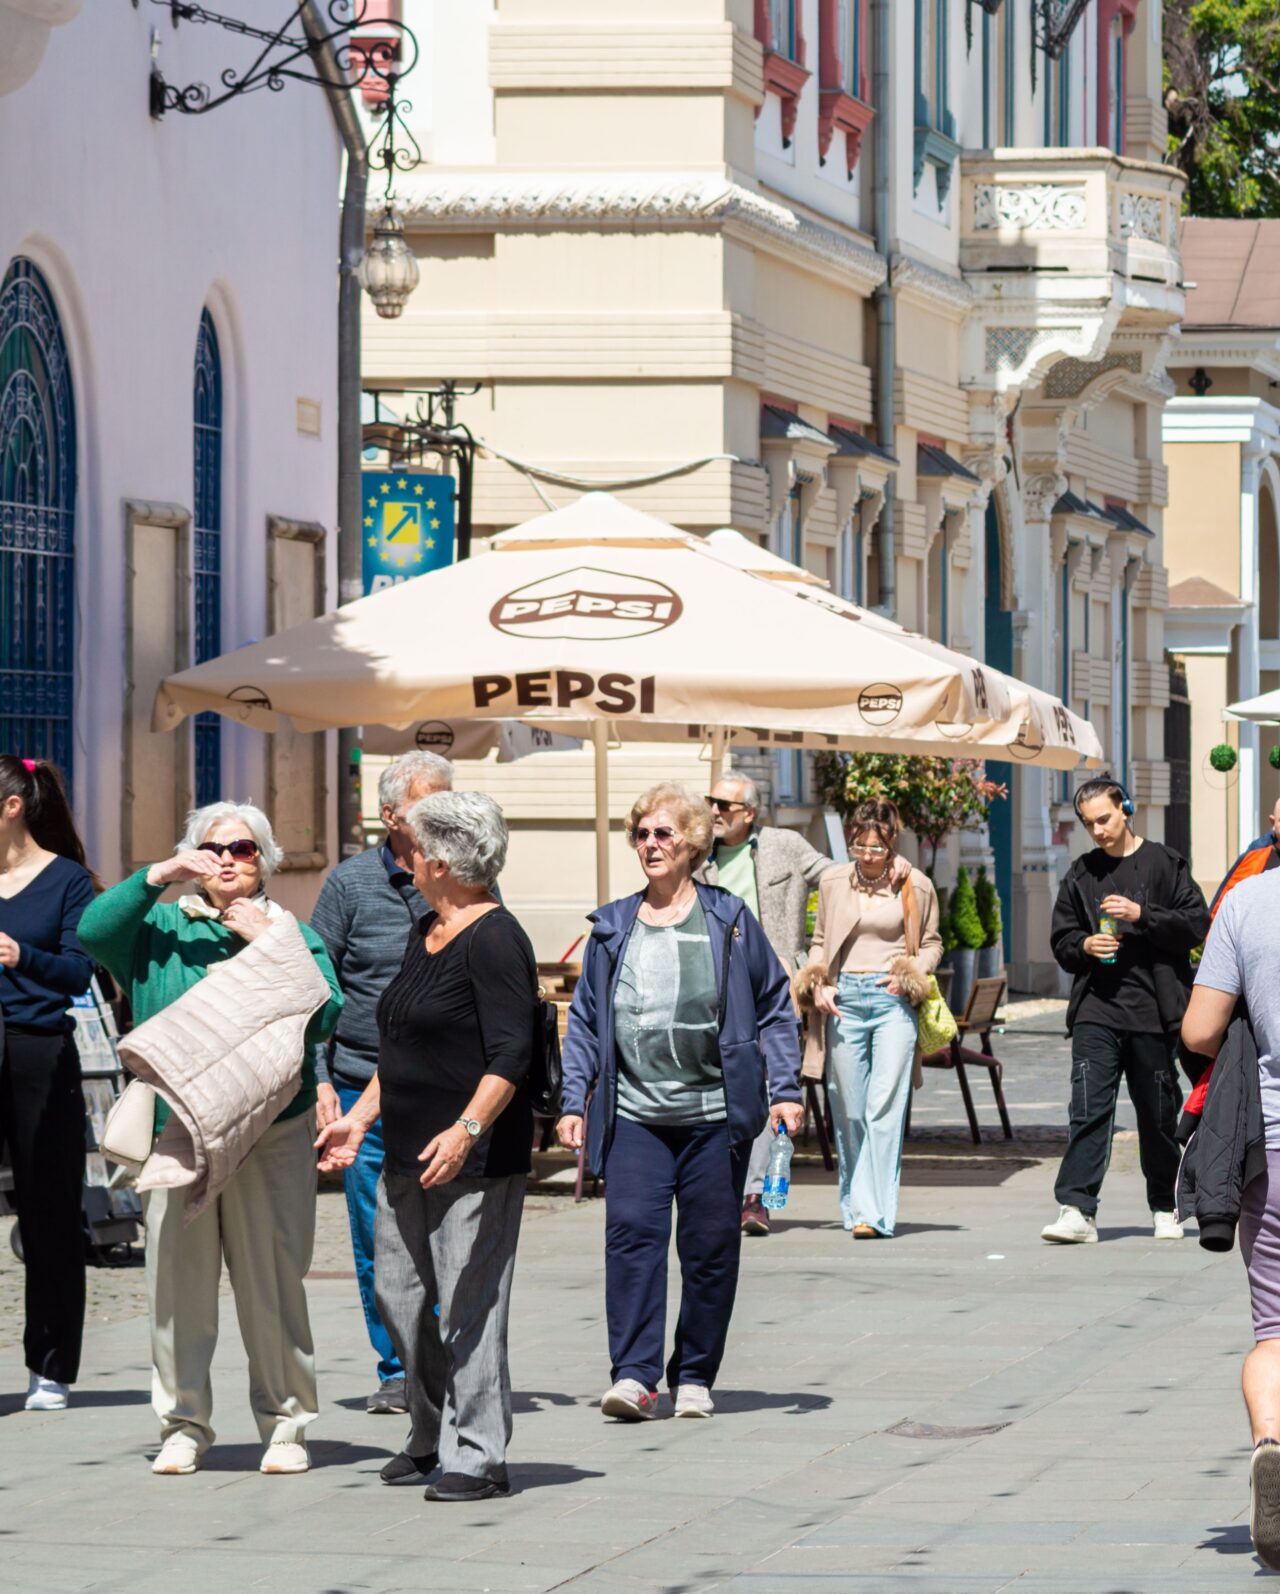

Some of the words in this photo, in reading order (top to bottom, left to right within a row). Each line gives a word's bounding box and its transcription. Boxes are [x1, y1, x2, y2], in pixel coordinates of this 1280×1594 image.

[499, 593, 673, 620] PEPSI
[472, 670, 655, 714] PEPSI
[860, 697, 901, 710] PEPSI
